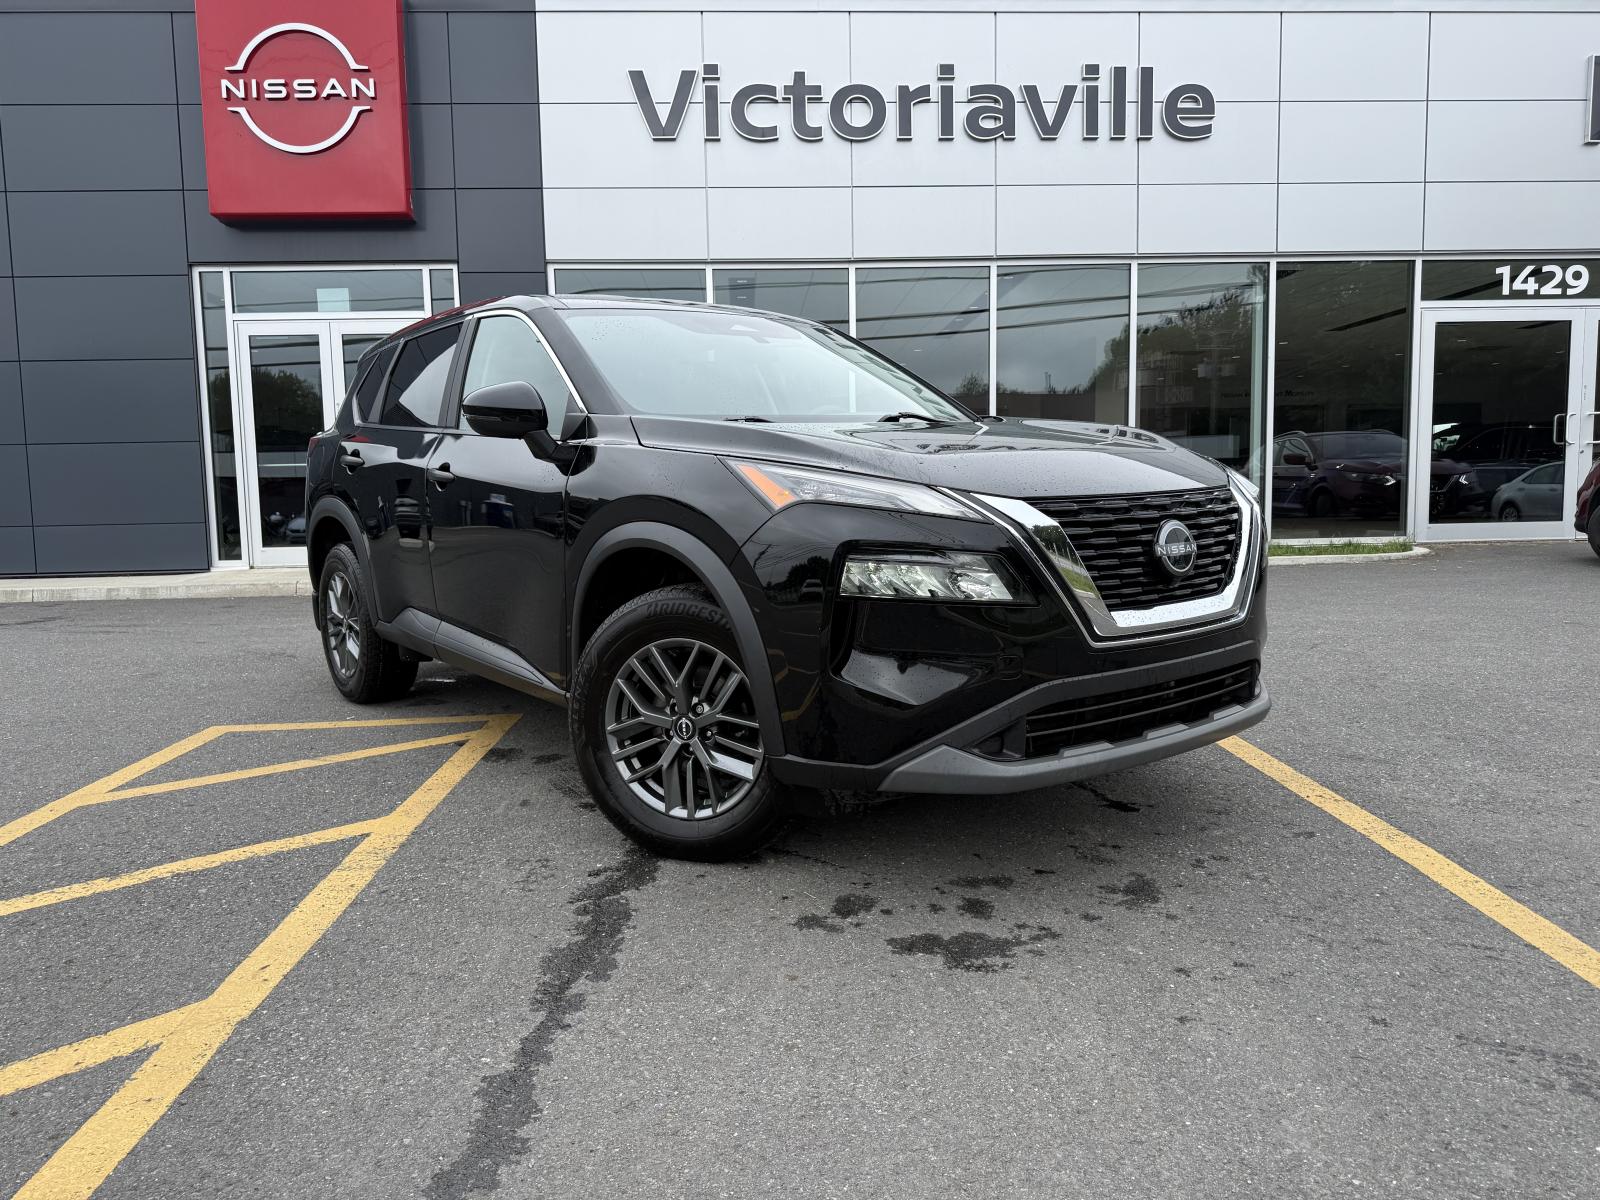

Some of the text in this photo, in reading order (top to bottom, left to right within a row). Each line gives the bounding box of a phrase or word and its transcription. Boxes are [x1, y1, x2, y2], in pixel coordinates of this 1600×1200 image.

[220, 78, 376, 100] NISSAN
[627, 63, 1217, 141] Victoriaville
[1495, 264, 1590, 296] 1429
[1157, 543, 1197, 555] NISSAN
